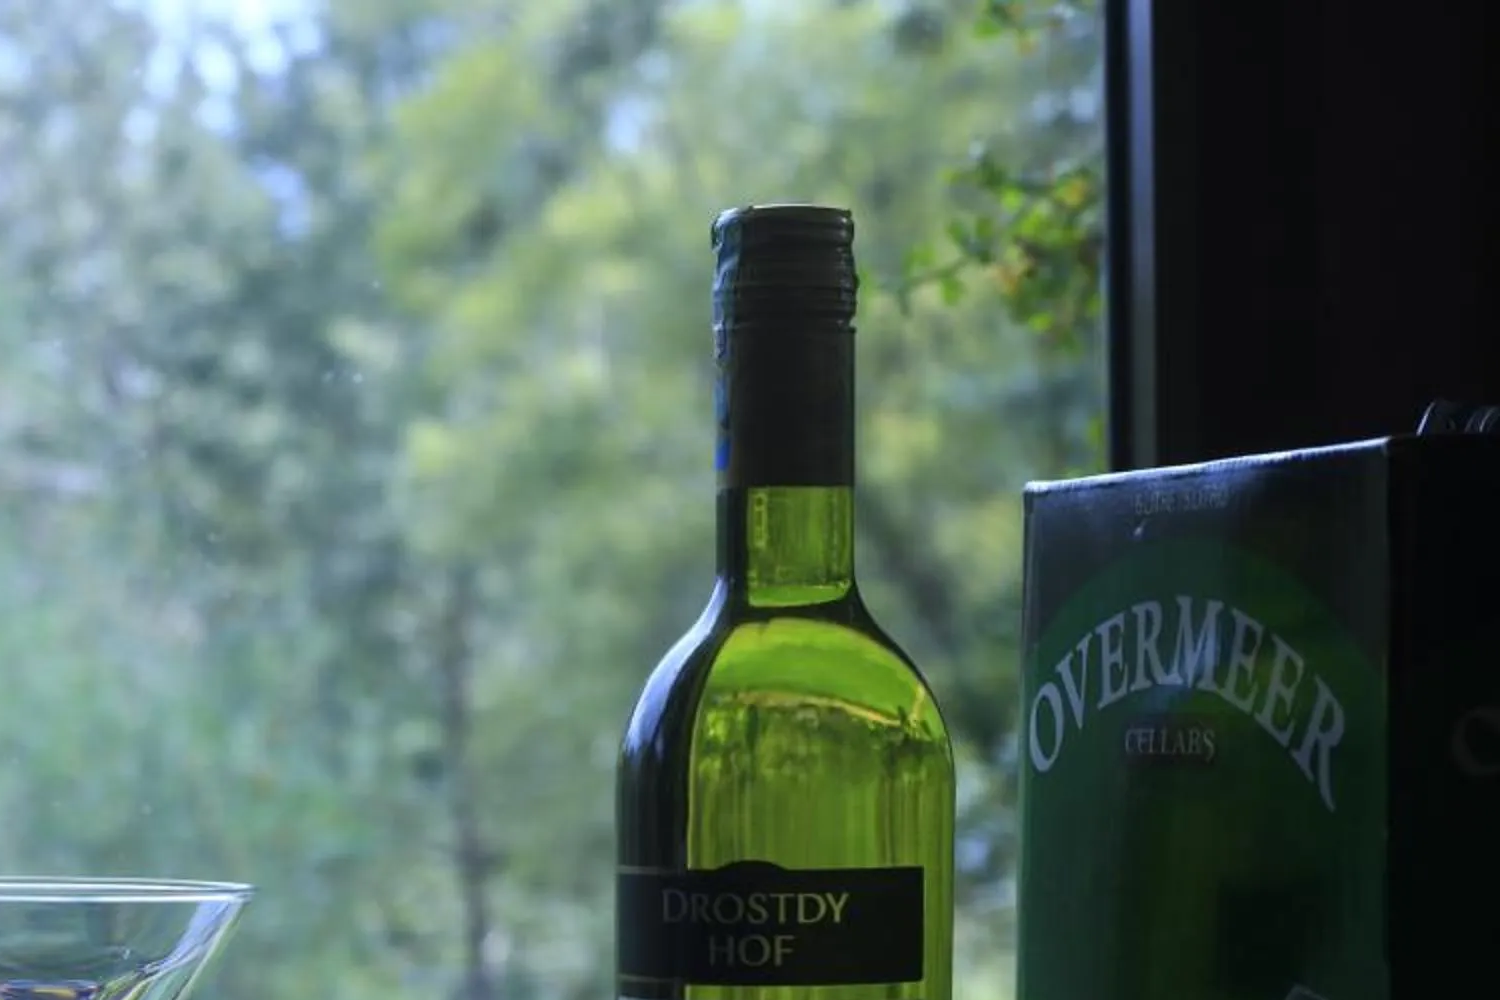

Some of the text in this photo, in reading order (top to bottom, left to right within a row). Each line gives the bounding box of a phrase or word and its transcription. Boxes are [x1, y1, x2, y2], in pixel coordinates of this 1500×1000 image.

[1029, 594, 1345, 813] OVERMEER
[1124, 726, 1216, 763] CELLARS
[661, 888, 851, 926] DROSTDY
[708, 934, 797, 967] HOF
